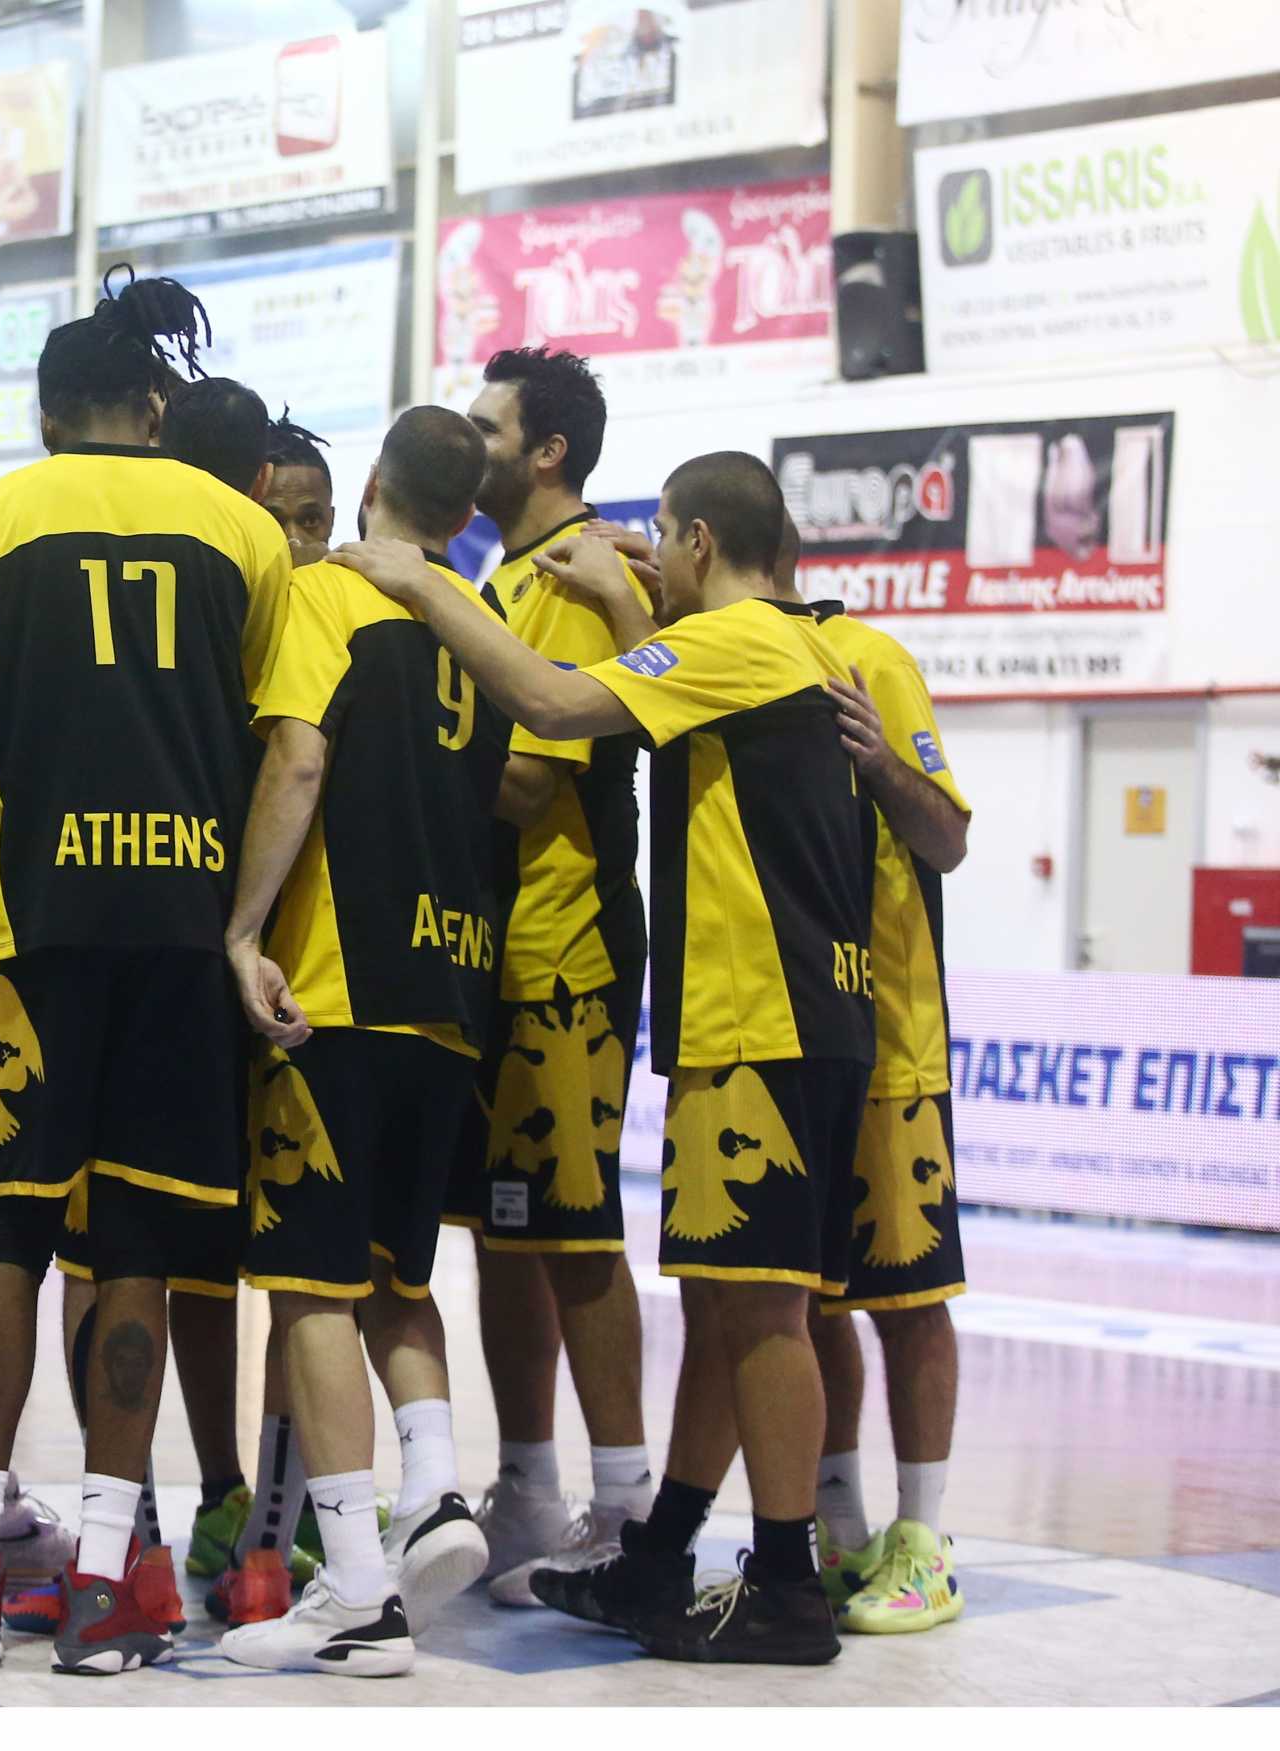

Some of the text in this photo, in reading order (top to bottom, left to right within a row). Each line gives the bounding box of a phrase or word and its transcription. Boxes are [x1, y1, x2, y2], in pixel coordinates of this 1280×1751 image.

[1001, 143, 1170, 228] ISSARIS
[79, 558, 177, 670] 17
[437, 645, 476, 752] 9
[55, 812, 226, 873] ATHENS
[1133, 1050, 1280, 1119] ΕΠΙΣΤ
